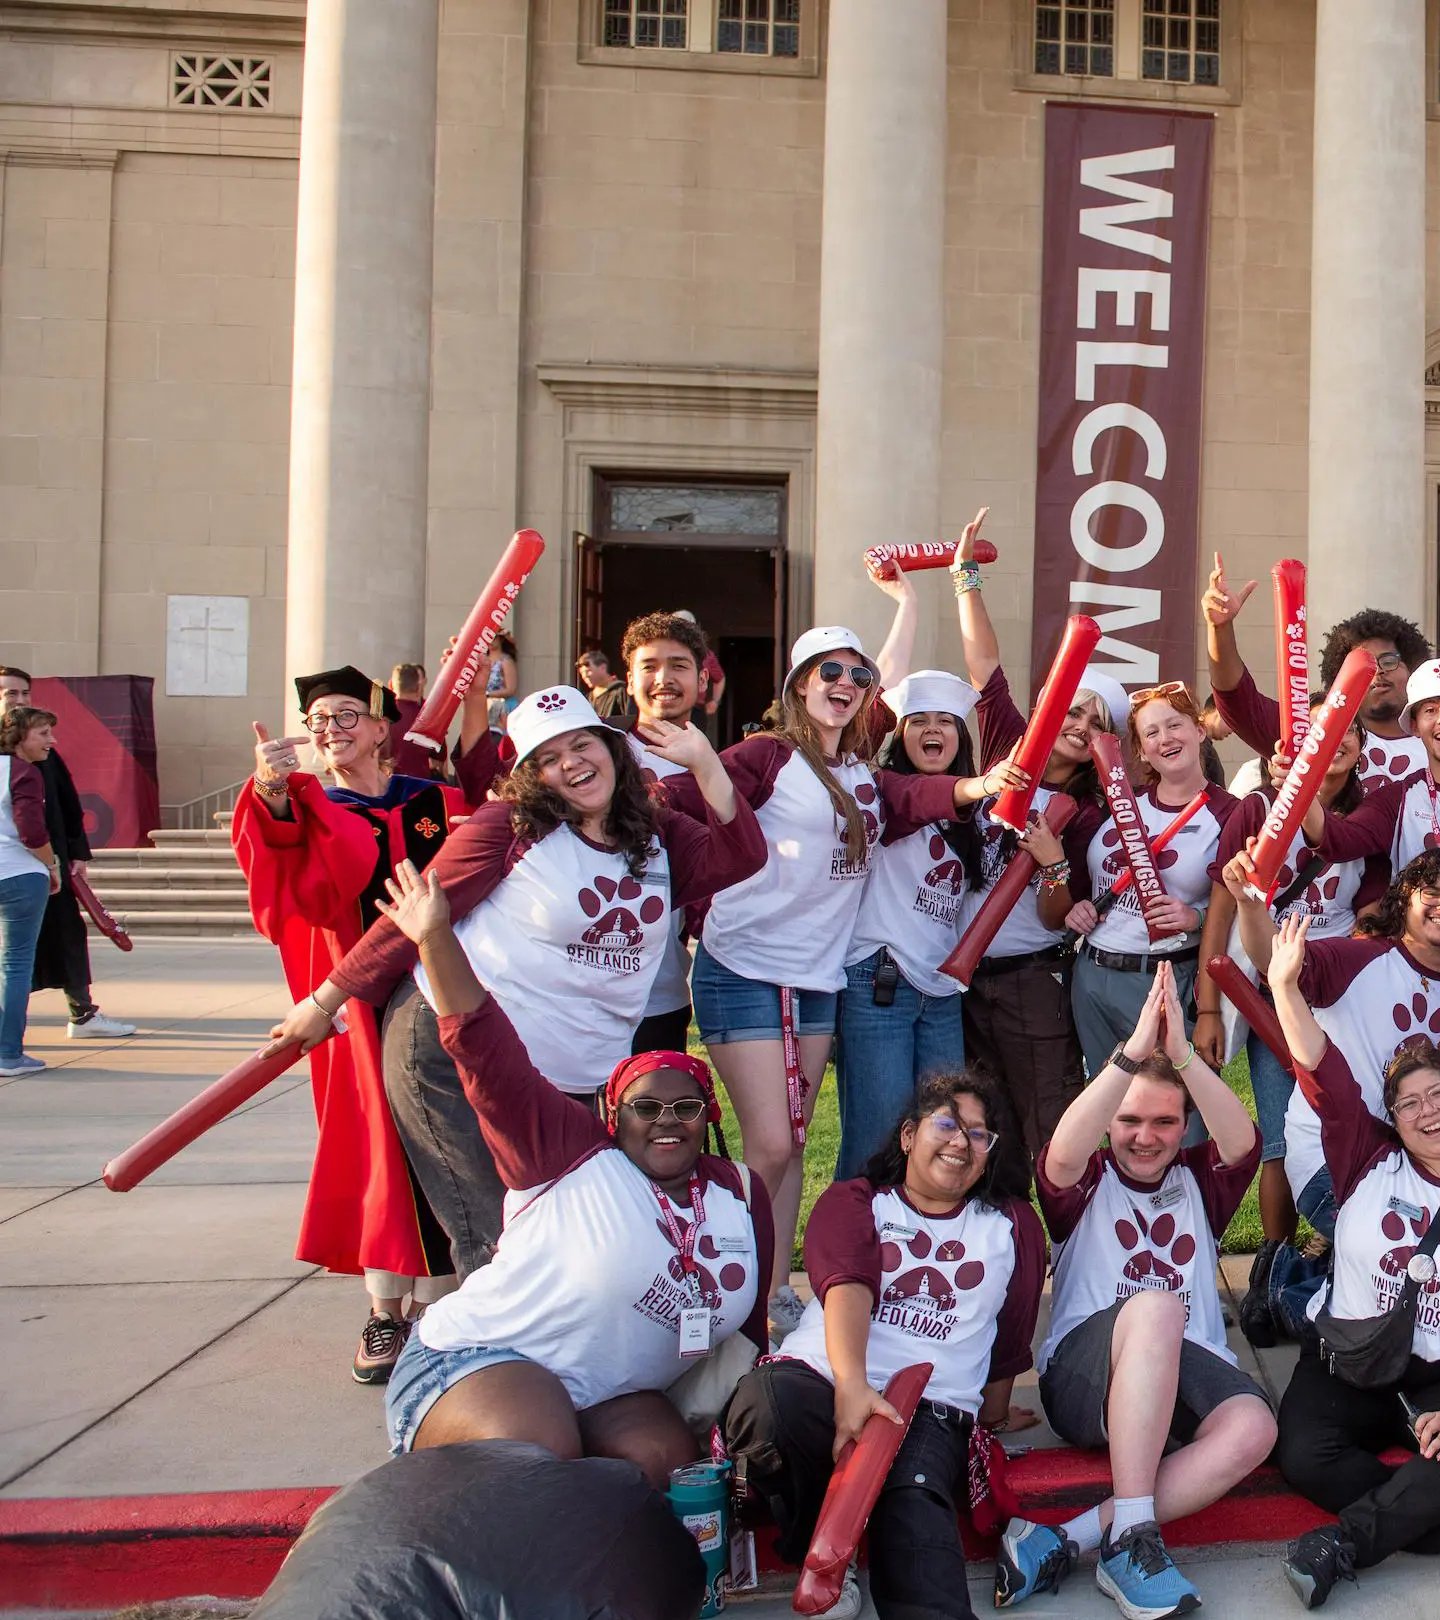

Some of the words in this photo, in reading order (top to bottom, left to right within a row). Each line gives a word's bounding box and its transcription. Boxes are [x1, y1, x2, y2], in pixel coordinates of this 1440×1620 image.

[1068, 145, 1175, 684] WELCOM
[488, 598, 513, 626] GO
[1286, 641, 1307, 668] GO
[1301, 720, 1326, 757] GO
[1109, 796, 1136, 825] GO
[1259, 762, 1309, 841] DAWGS!
[1120, 826, 1162, 898] DAWGS!
[640, 1287, 681, 1325] REDLA
[652, 1273, 693, 1308] UNIVERS
[944, 1313, 960, 1326] OF
